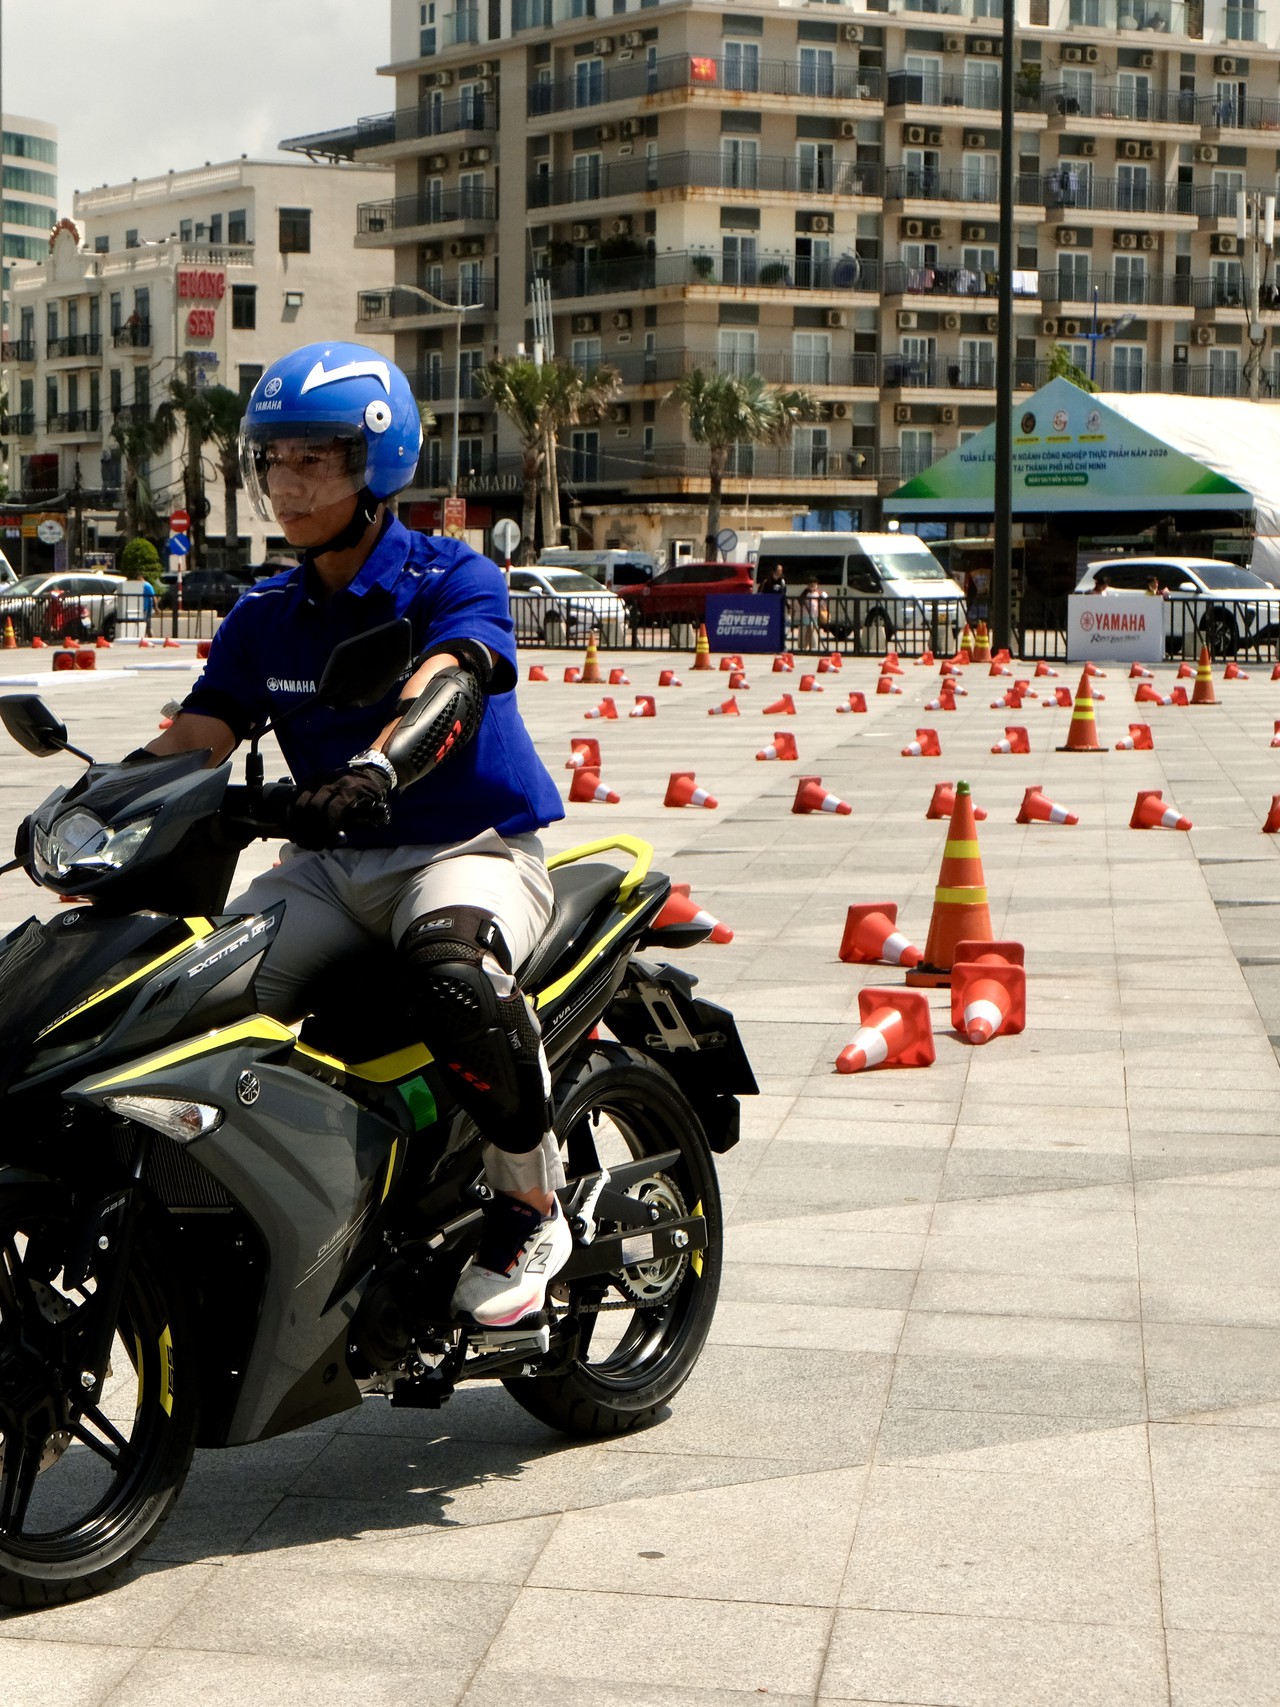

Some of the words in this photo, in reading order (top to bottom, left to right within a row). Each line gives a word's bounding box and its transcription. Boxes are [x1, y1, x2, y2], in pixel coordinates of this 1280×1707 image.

[188, 309, 215, 337] SEN
[255, 400, 282, 412] YAMAHA
[1095, 613, 1146, 632] YAMAHA
[277, 679, 316, 693] YAMAHA
[187, 933, 250, 979] EXCITER
[552, 1005, 571, 1025] VVA
